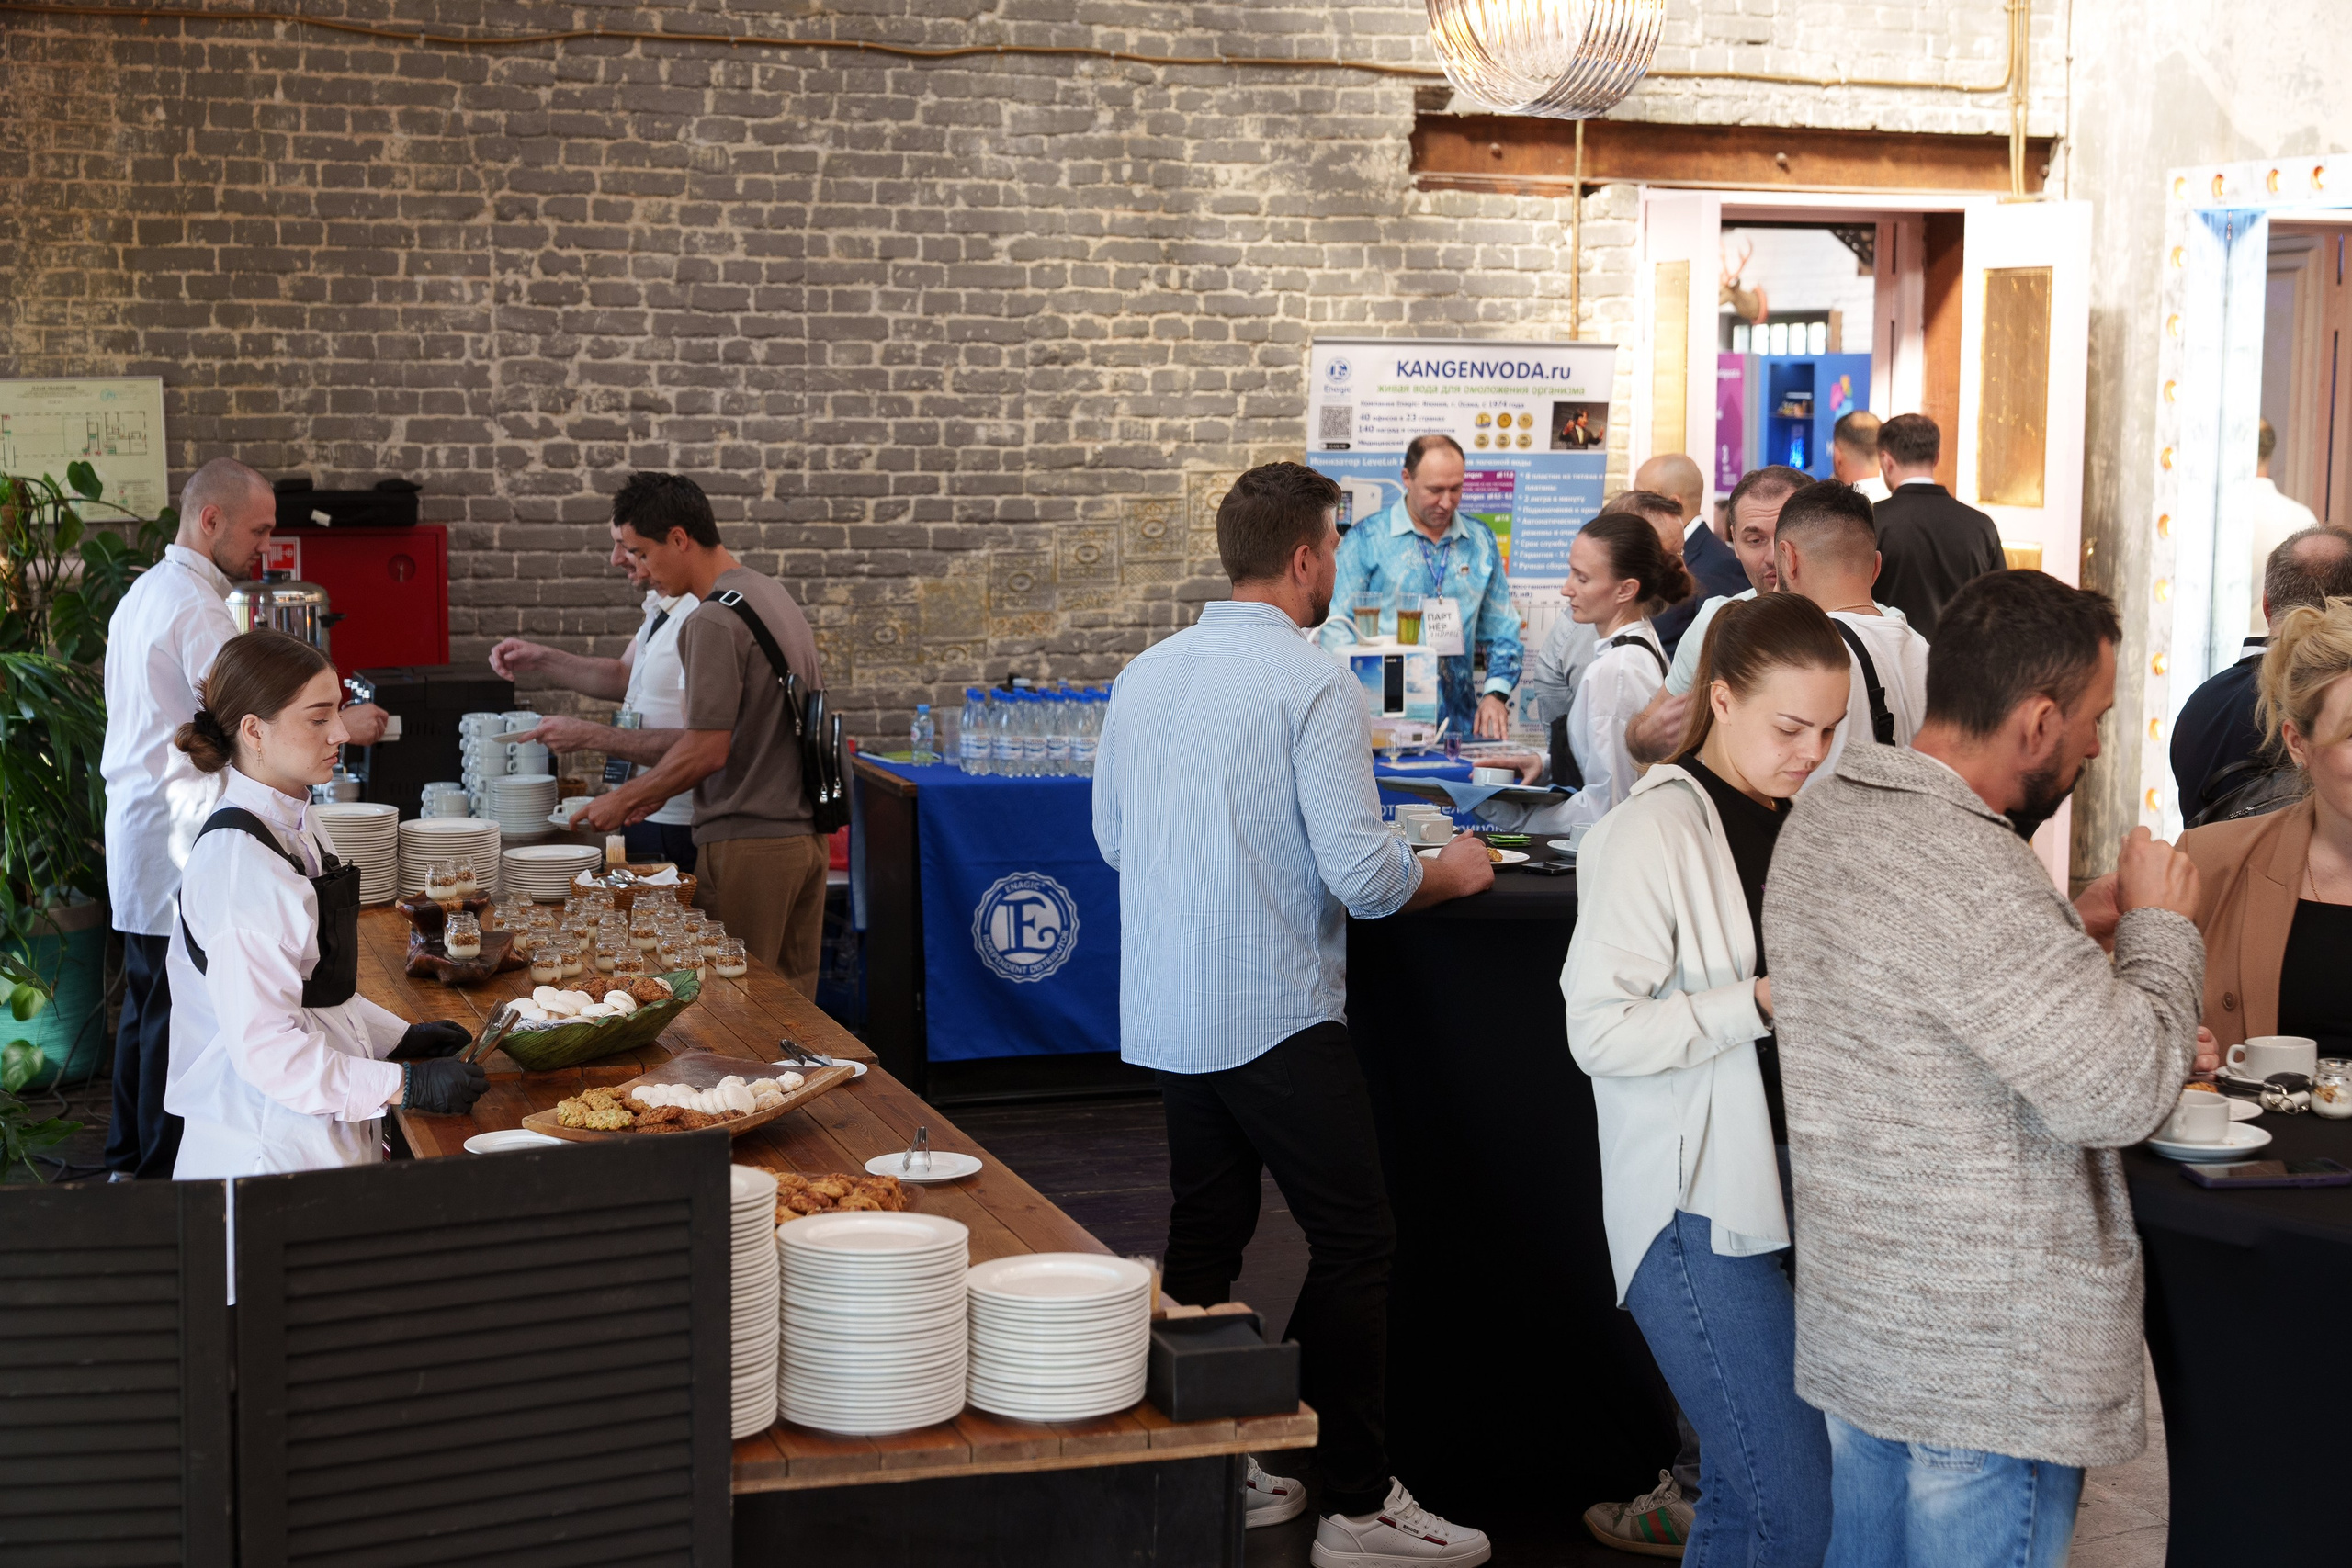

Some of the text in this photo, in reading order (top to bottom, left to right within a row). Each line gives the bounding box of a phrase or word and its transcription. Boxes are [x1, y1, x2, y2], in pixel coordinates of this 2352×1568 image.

[1396, 359, 1571, 380] KANGENVODA.ru
[1377, 384, 1585, 397] живая вода для омоложения организма
[1309, 457, 1360, 468] Ионизатор
[1427, 613, 1452, 621] ПАРТ
[982, 934, 1027, 974] INDEPENDENT
[1029, 929, 1069, 974] DISTRIBUTOR
